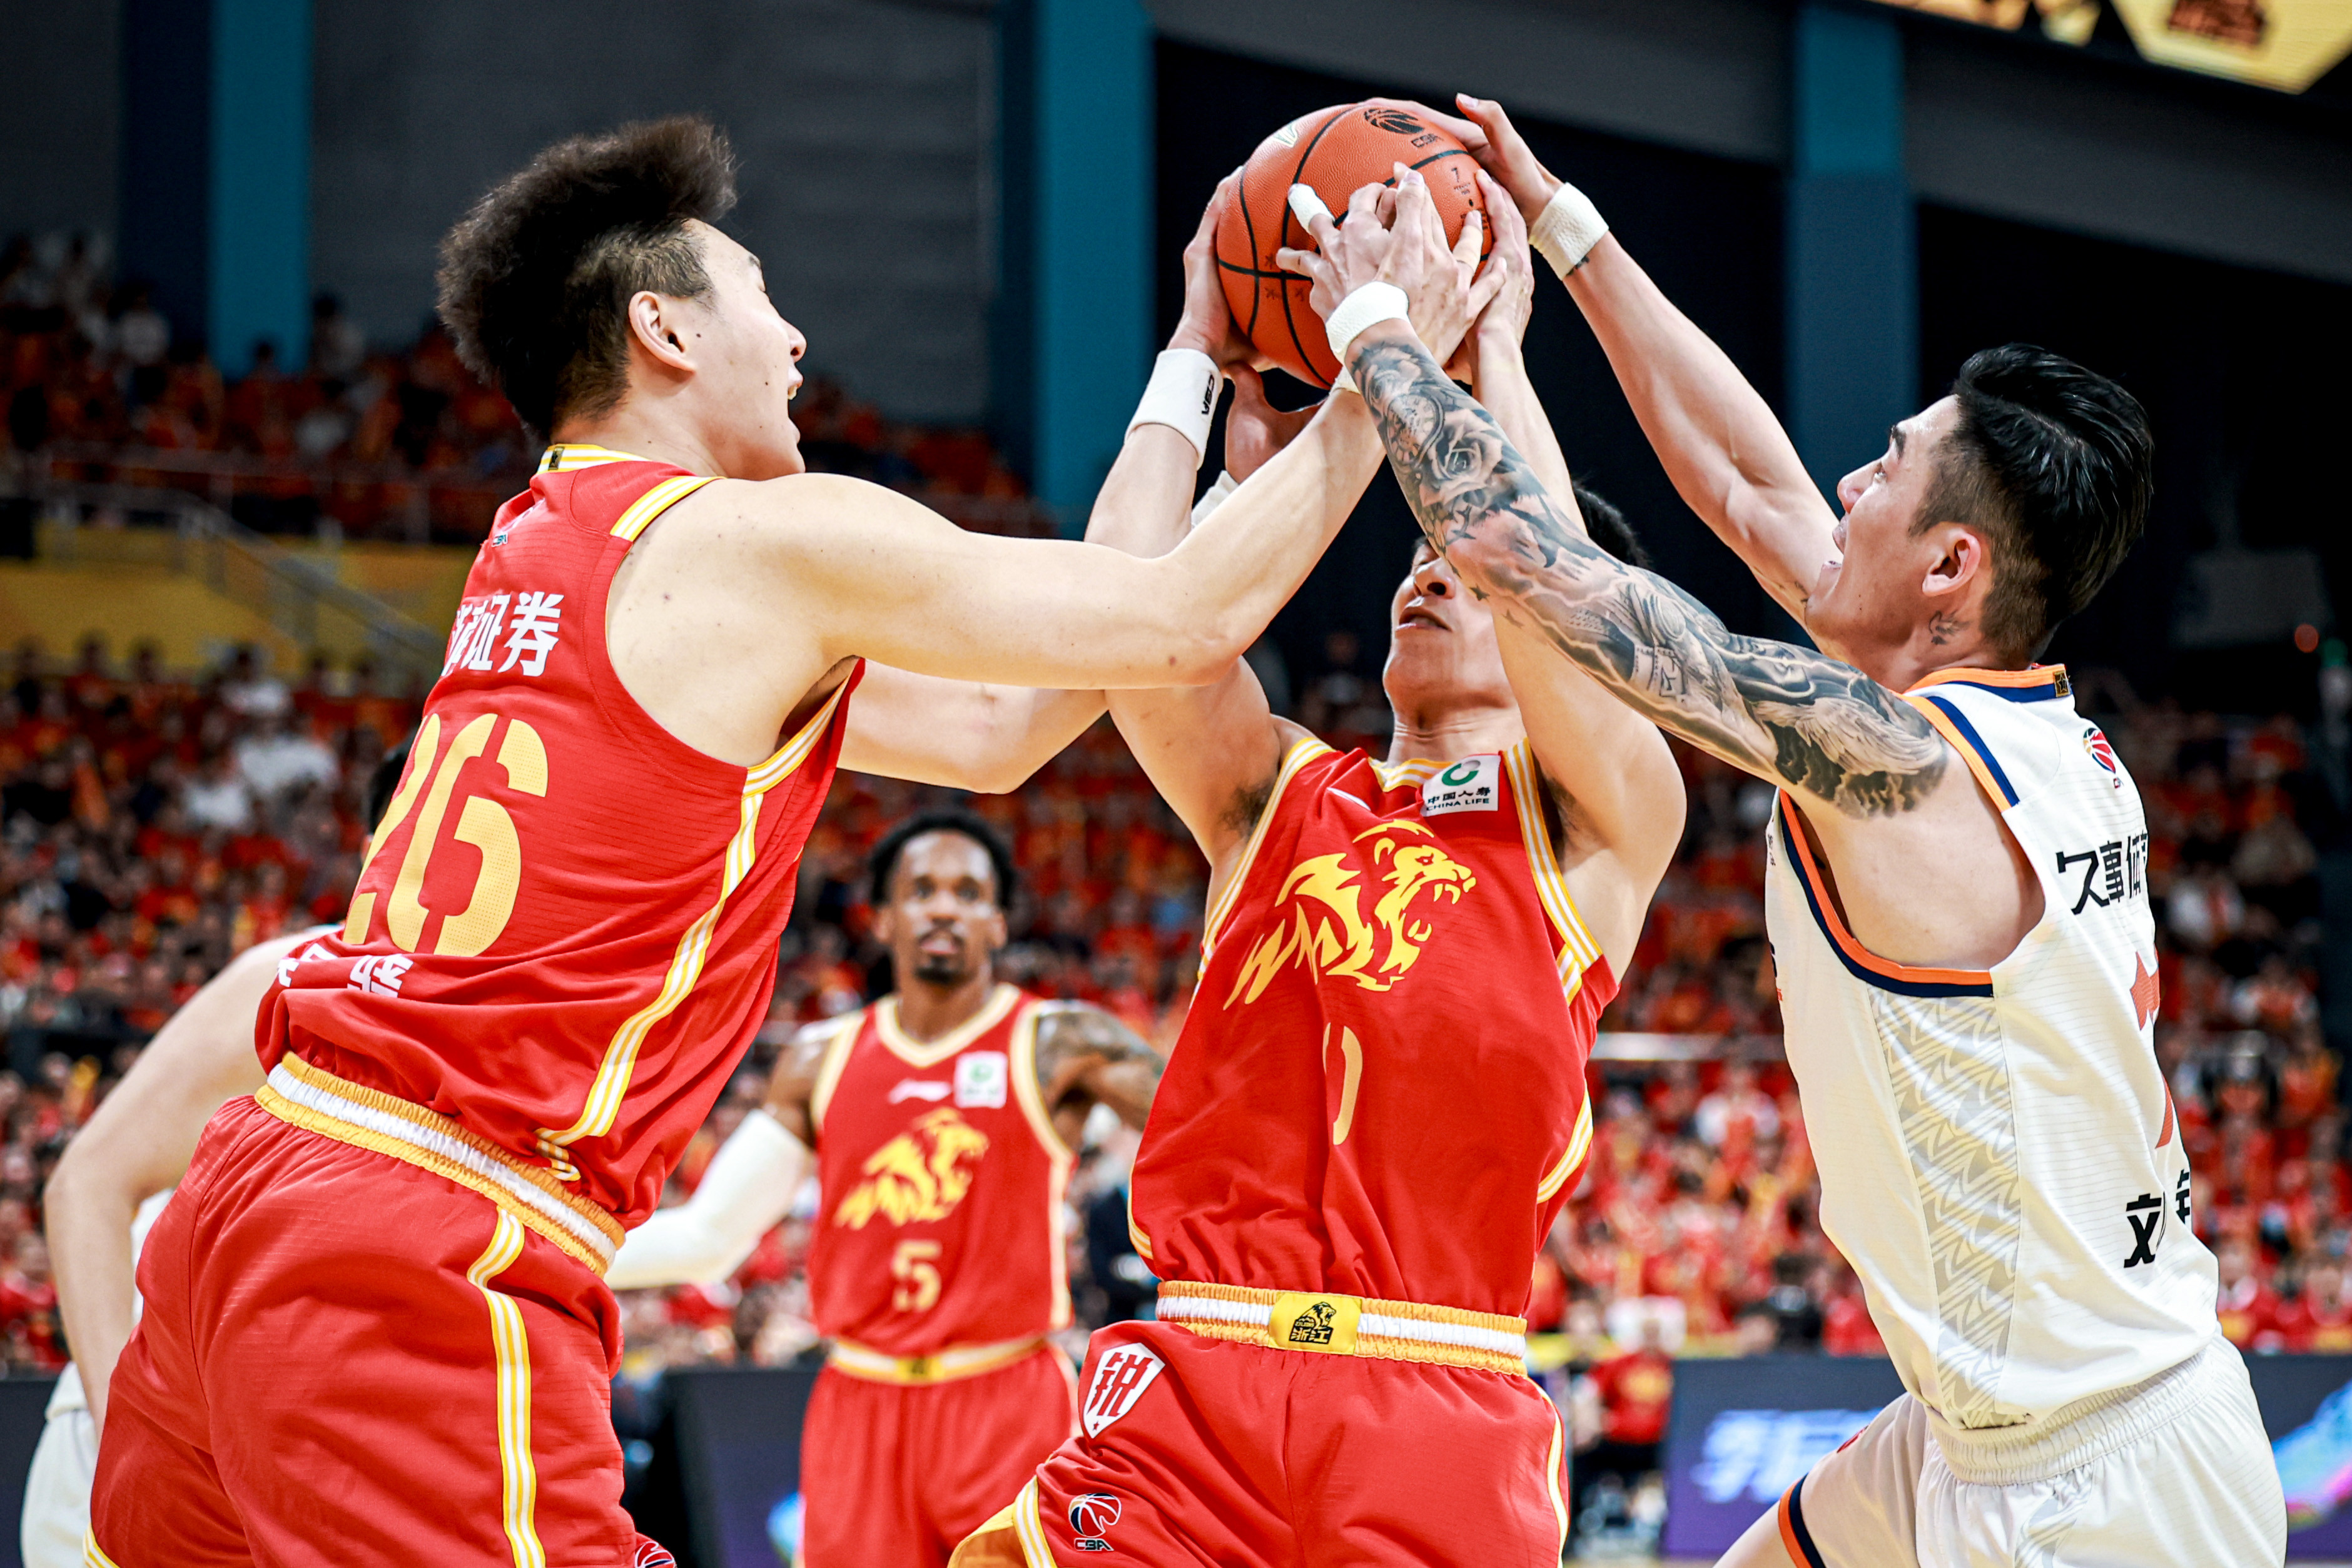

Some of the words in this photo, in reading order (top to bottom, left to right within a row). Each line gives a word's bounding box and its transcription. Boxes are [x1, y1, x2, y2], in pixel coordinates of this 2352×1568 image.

[1201, 373, 1215, 415] CBA
[1426, 801, 1461, 811] CHINA
[891, 1240, 942, 1312] 5
[1290, 1327, 1331, 1343] 浙江
[1073, 1537, 1115, 1552] CBA
